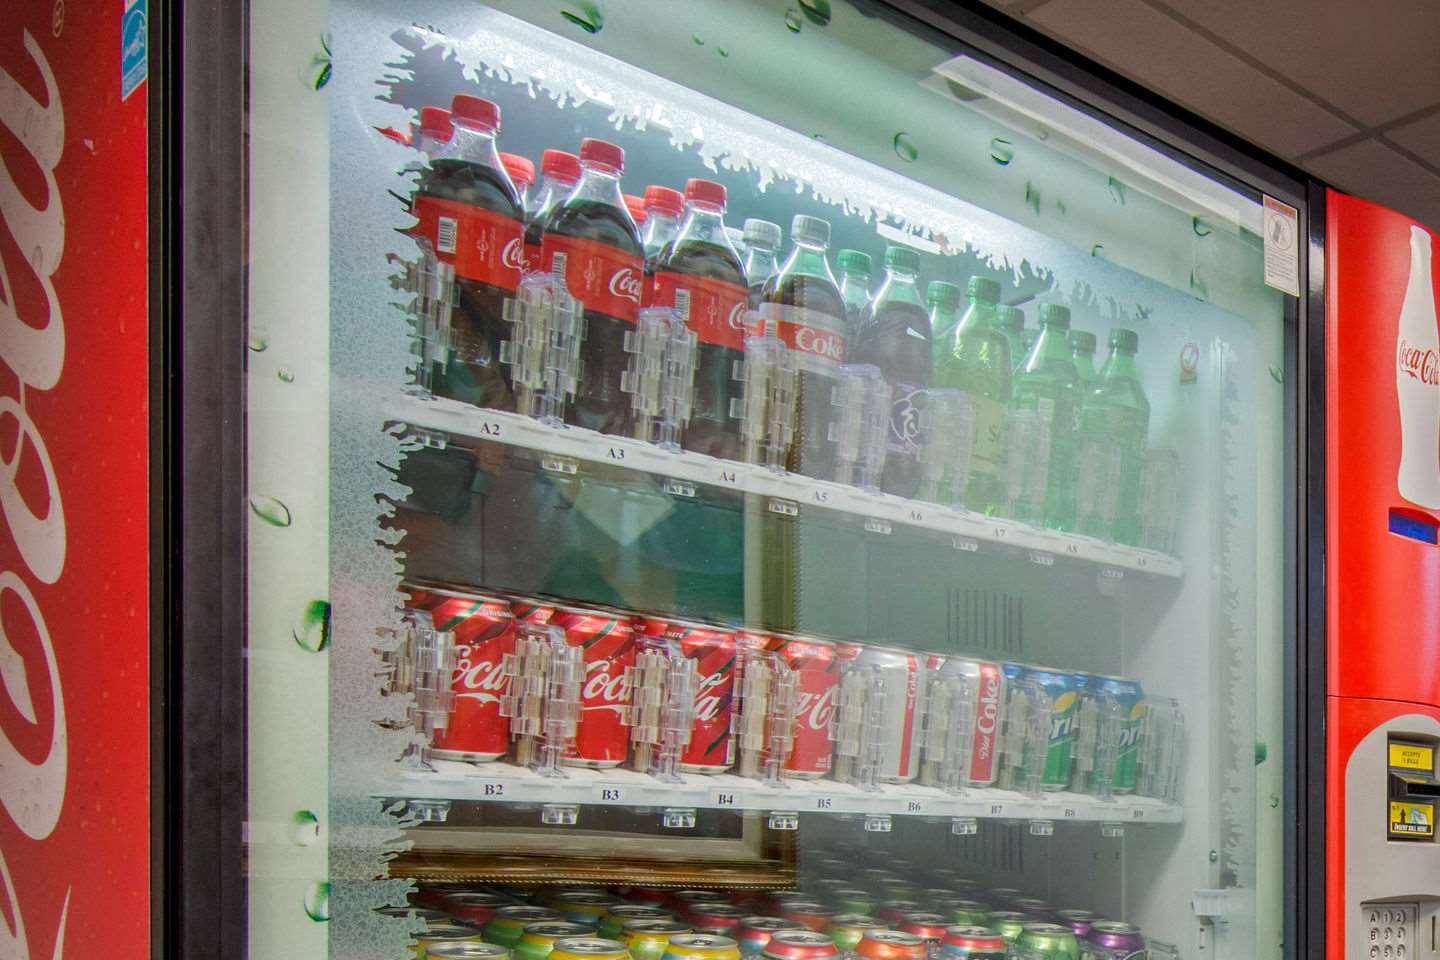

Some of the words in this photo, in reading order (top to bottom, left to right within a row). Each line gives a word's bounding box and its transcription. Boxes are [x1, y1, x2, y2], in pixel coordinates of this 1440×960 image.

[795, 325, 845, 362] Coke
[1399, 339, 1440, 386] Coca-Cola
[480, 423, 500, 436] A2
[607, 447, 625, 460] A3
[720, 472, 736, 483] A4
[813, 490, 828, 503] A5
[910, 510, 923, 522] A6
[976, 679, 1000, 734] Coke
[485, 784, 504, 796] B2
[602, 789, 619, 801] B3
[718, 794, 733, 804] B4
[817, 798, 831, 809] B5
[908, 801, 921, 812] B6
[992, 804, 1003, 815] B7
